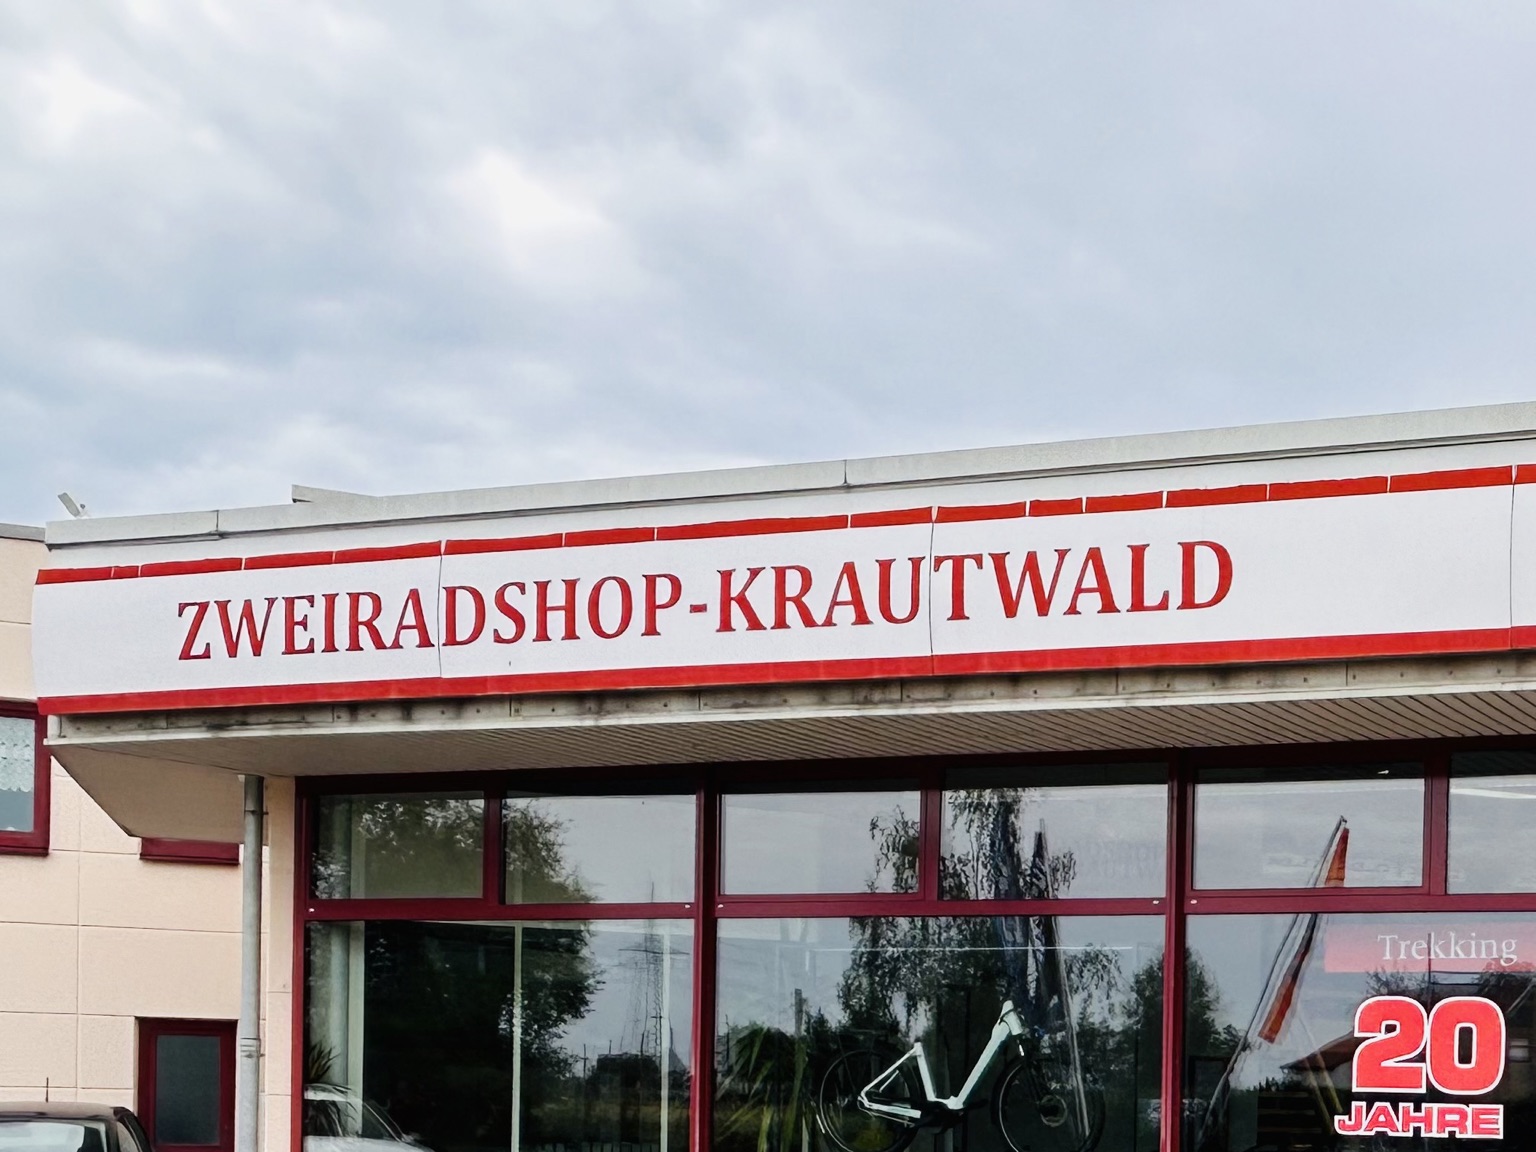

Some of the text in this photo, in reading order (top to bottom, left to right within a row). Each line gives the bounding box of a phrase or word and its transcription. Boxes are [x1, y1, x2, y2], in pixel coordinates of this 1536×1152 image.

[177, 540, 1234, 661] ZWEIRADSHOP-KRAUTWALD
[1378, 931, 1518, 967] Trekking
[1352, 995, 1506, 1095] 20
[1334, 1101, 1503, 1139] JAHRE
